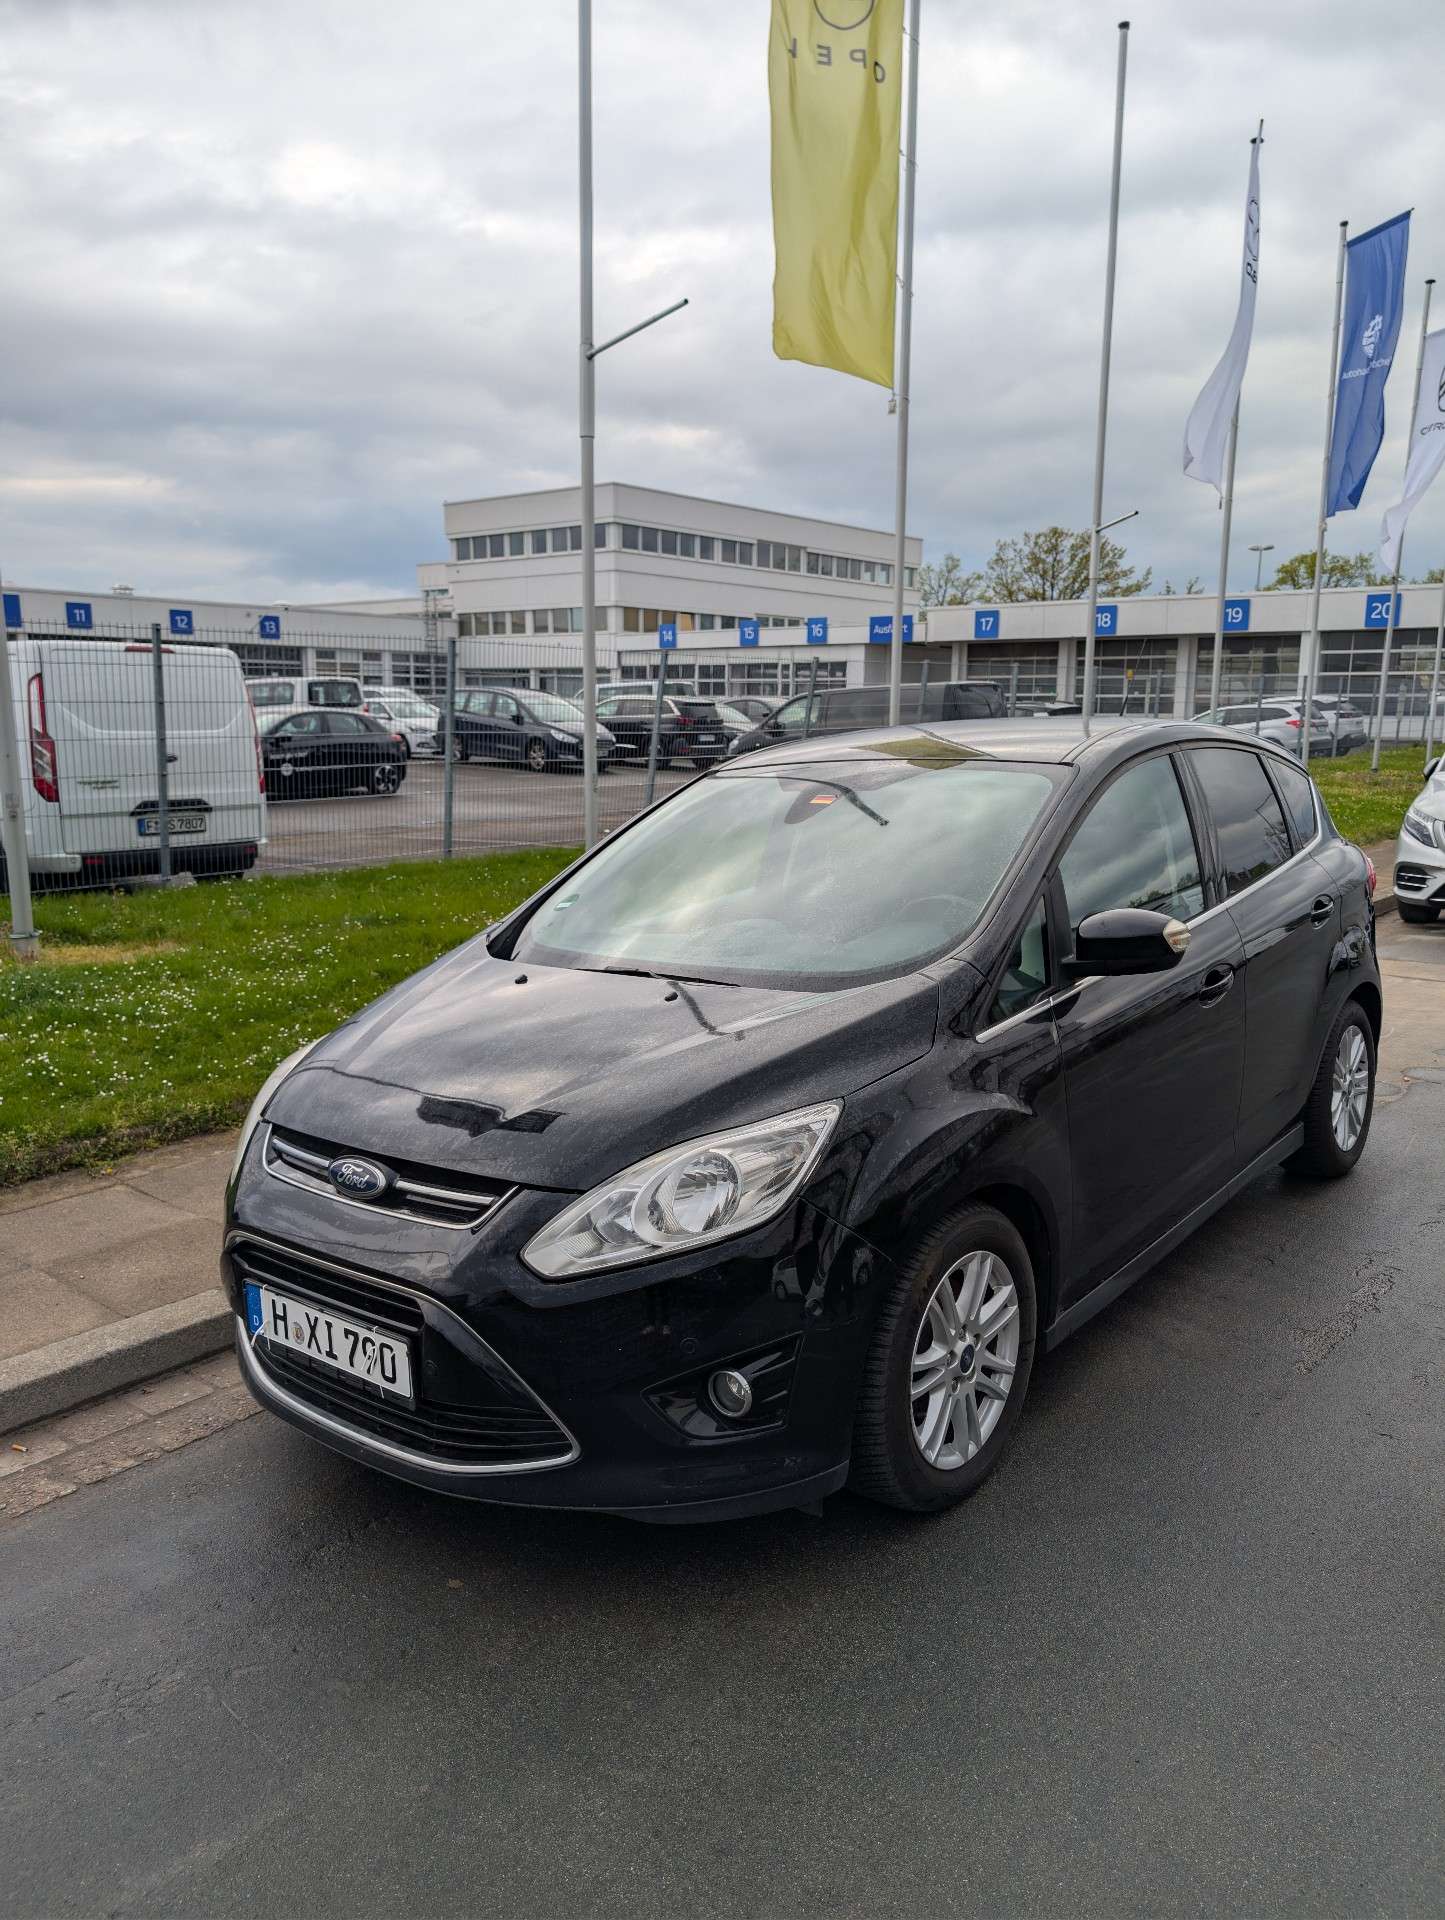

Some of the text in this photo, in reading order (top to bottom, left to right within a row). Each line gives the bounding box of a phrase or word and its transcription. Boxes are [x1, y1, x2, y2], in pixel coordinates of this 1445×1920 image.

[73, 608, 86, 622] 11
[1225, 607, 1243, 623] 19
[1370, 602, 1392, 619] 20
[175, 616, 188, 628] 12
[264, 621, 276, 633] 13
[979, 617, 994, 631] 17
[1096, 613, 1112, 627] 18
[662, 630, 673, 642] 14
[744, 627, 755, 640] 15
[811, 624, 823, 637] 16
[337, 1163, 370, 1188] Ford
[271, 1298, 289, 1340] H
